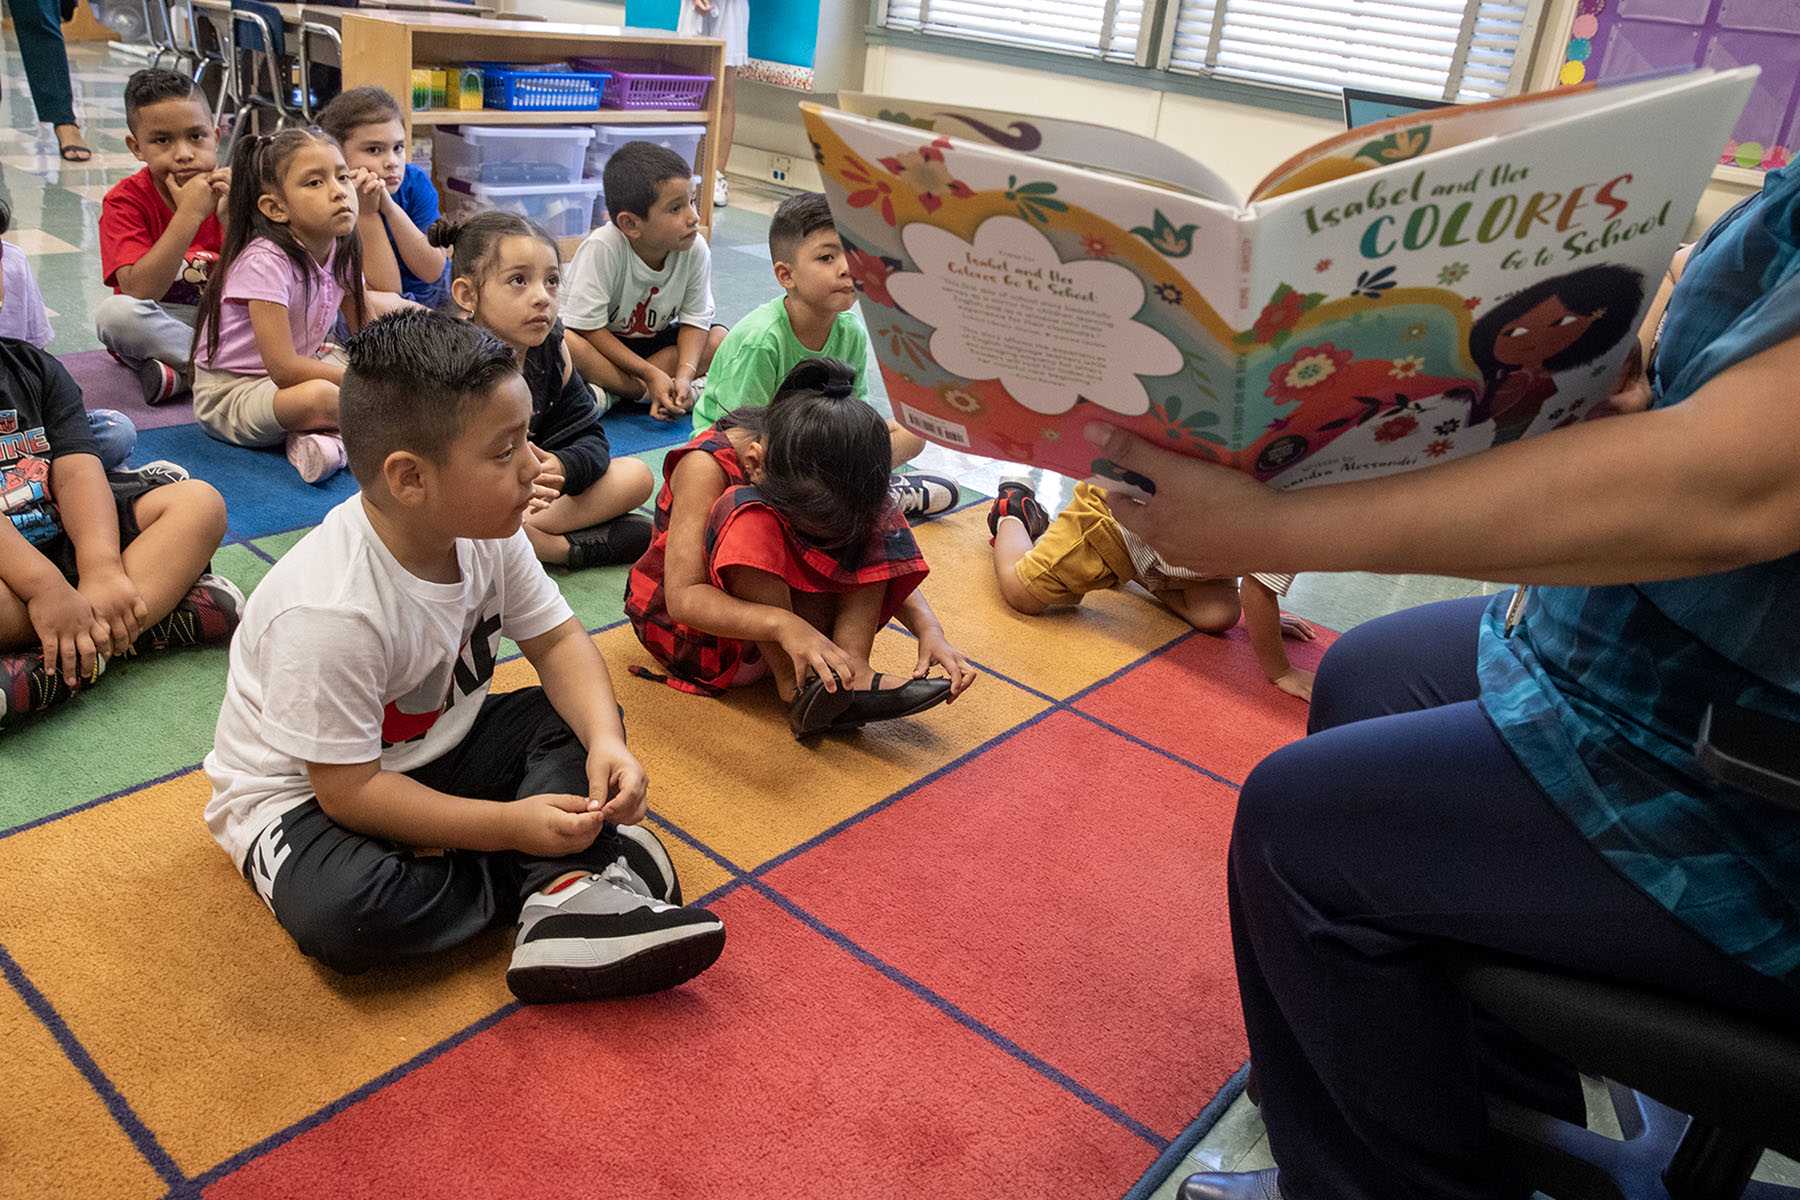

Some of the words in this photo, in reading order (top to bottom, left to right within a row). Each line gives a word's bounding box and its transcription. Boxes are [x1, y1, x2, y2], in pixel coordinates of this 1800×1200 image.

[1304, 171, 1426, 234] Isabel
[1431, 169, 1480, 196] and
[1490, 163, 1530, 187] Her
[1360, 173, 1633, 259] COLORES
[1501, 249, 1527, 270] Go
[1534, 246, 1553, 267] to
[1563, 200, 1672, 261] School
[965, 252, 1009, 272] Isabel
[1015, 267, 1042, 279] and
[1003, 274, 1021, 288] Go
[1028, 279, 1041, 292] to
[0, 427, 51, 461] ME
